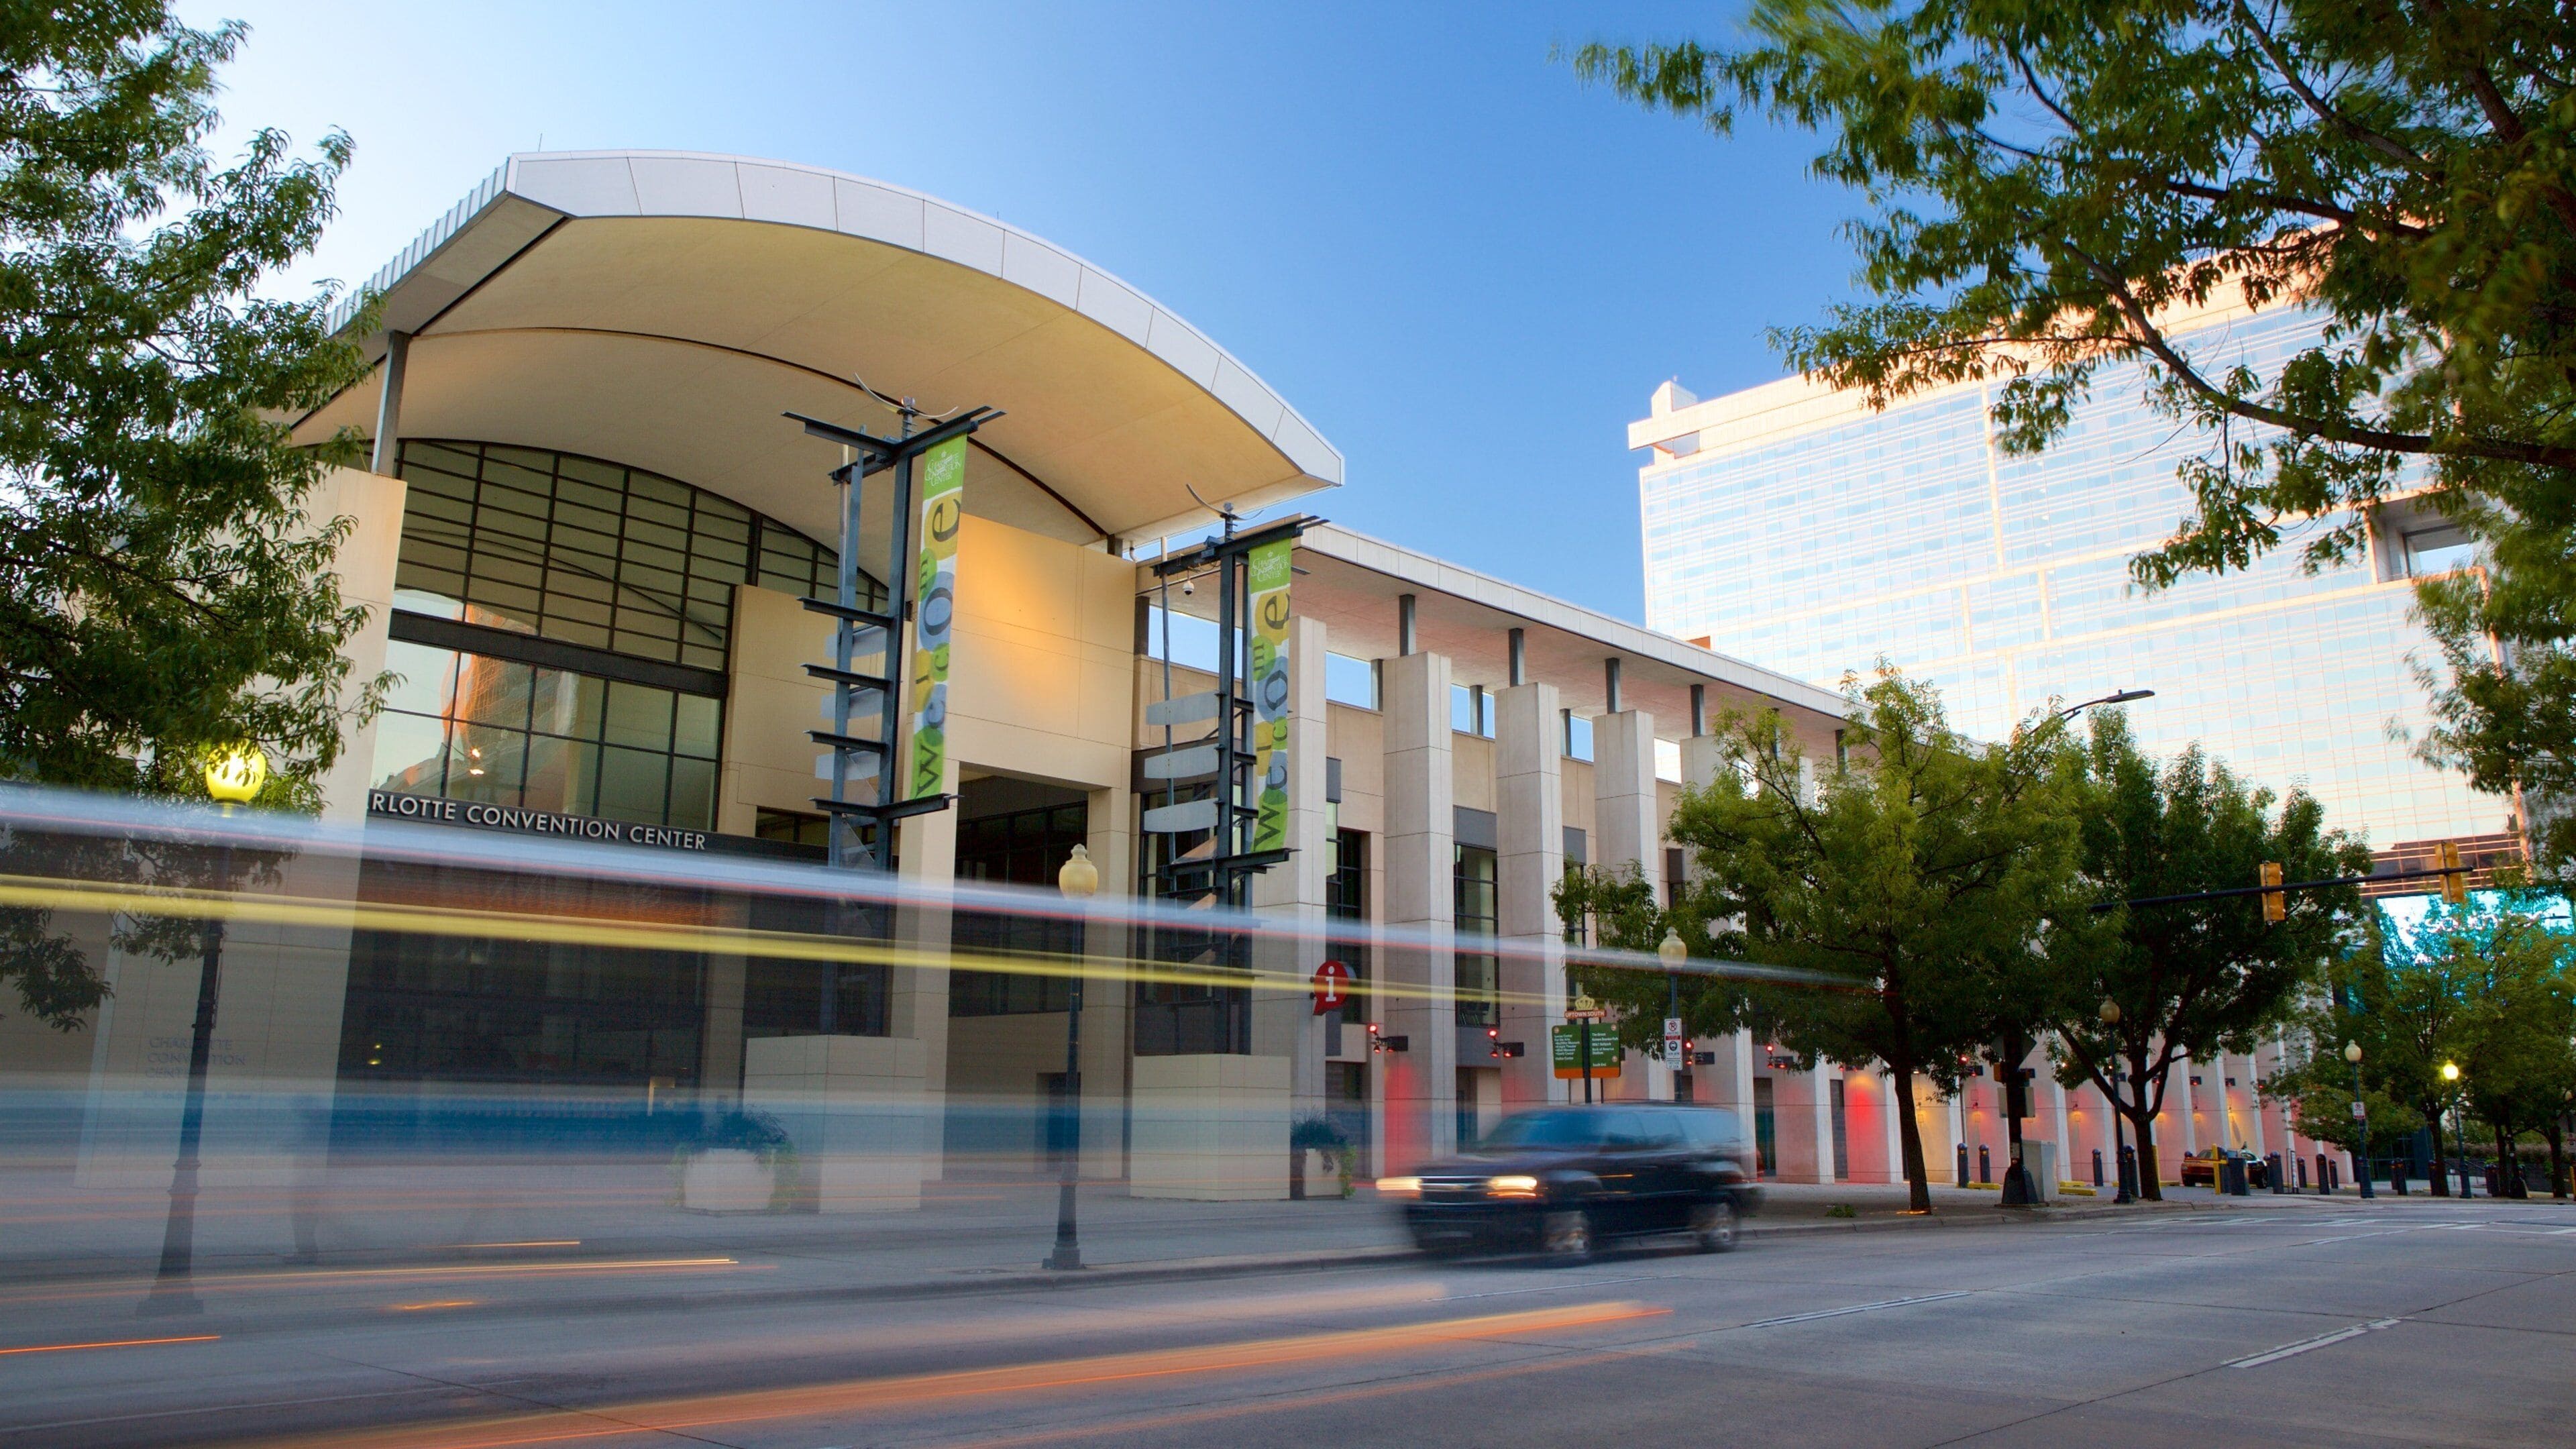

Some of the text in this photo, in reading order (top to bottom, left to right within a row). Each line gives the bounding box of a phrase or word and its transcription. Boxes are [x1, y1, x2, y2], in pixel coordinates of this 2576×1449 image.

[915, 498, 961, 798] welcome
[1254, 592, 1290, 851] welcome
[371, 792, 706, 851] RLOTTE CONVENTION CENTER
